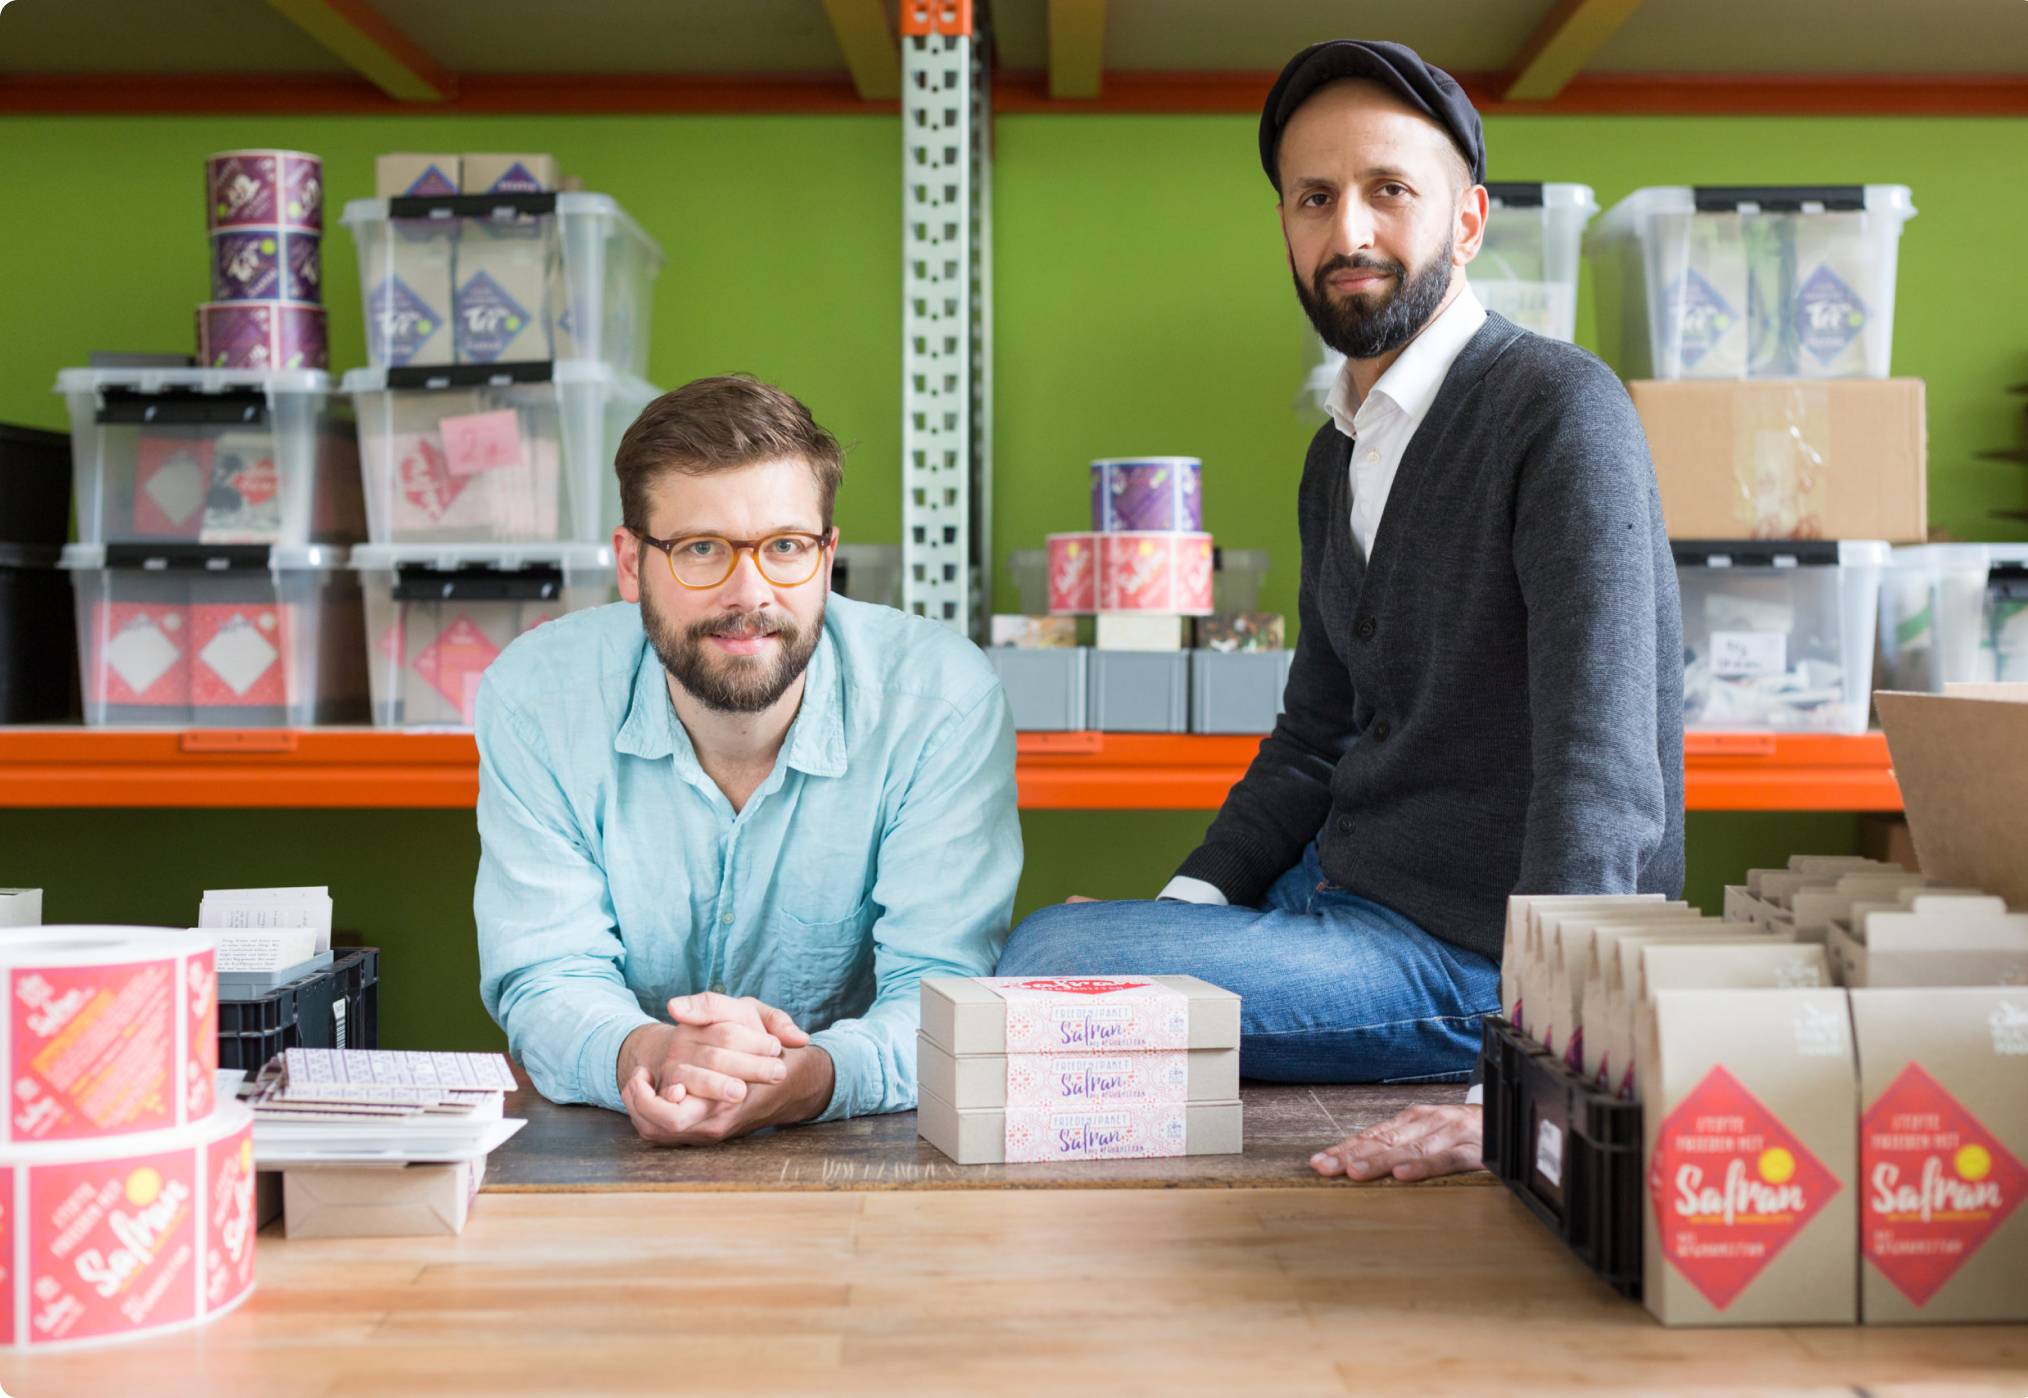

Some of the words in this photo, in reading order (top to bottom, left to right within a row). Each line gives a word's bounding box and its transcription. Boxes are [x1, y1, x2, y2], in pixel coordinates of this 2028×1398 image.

[1054, 1007, 1129, 1019] FRIEDENSPAKET
[1060, 1014, 1122, 1046] Safran
[1055, 1060, 1129, 1071] FRIEDENSPAKET
[1061, 1067, 1122, 1098] Safran
[1053, 1114, 1127, 1126] FRIEDENSPAKET
[1059, 1122, 1121, 1154] Safran
[1674, 1157, 1806, 1226] Safran
[1871, 1155, 2003, 1223] Safran
[74, 1179, 190, 1298] Safran
